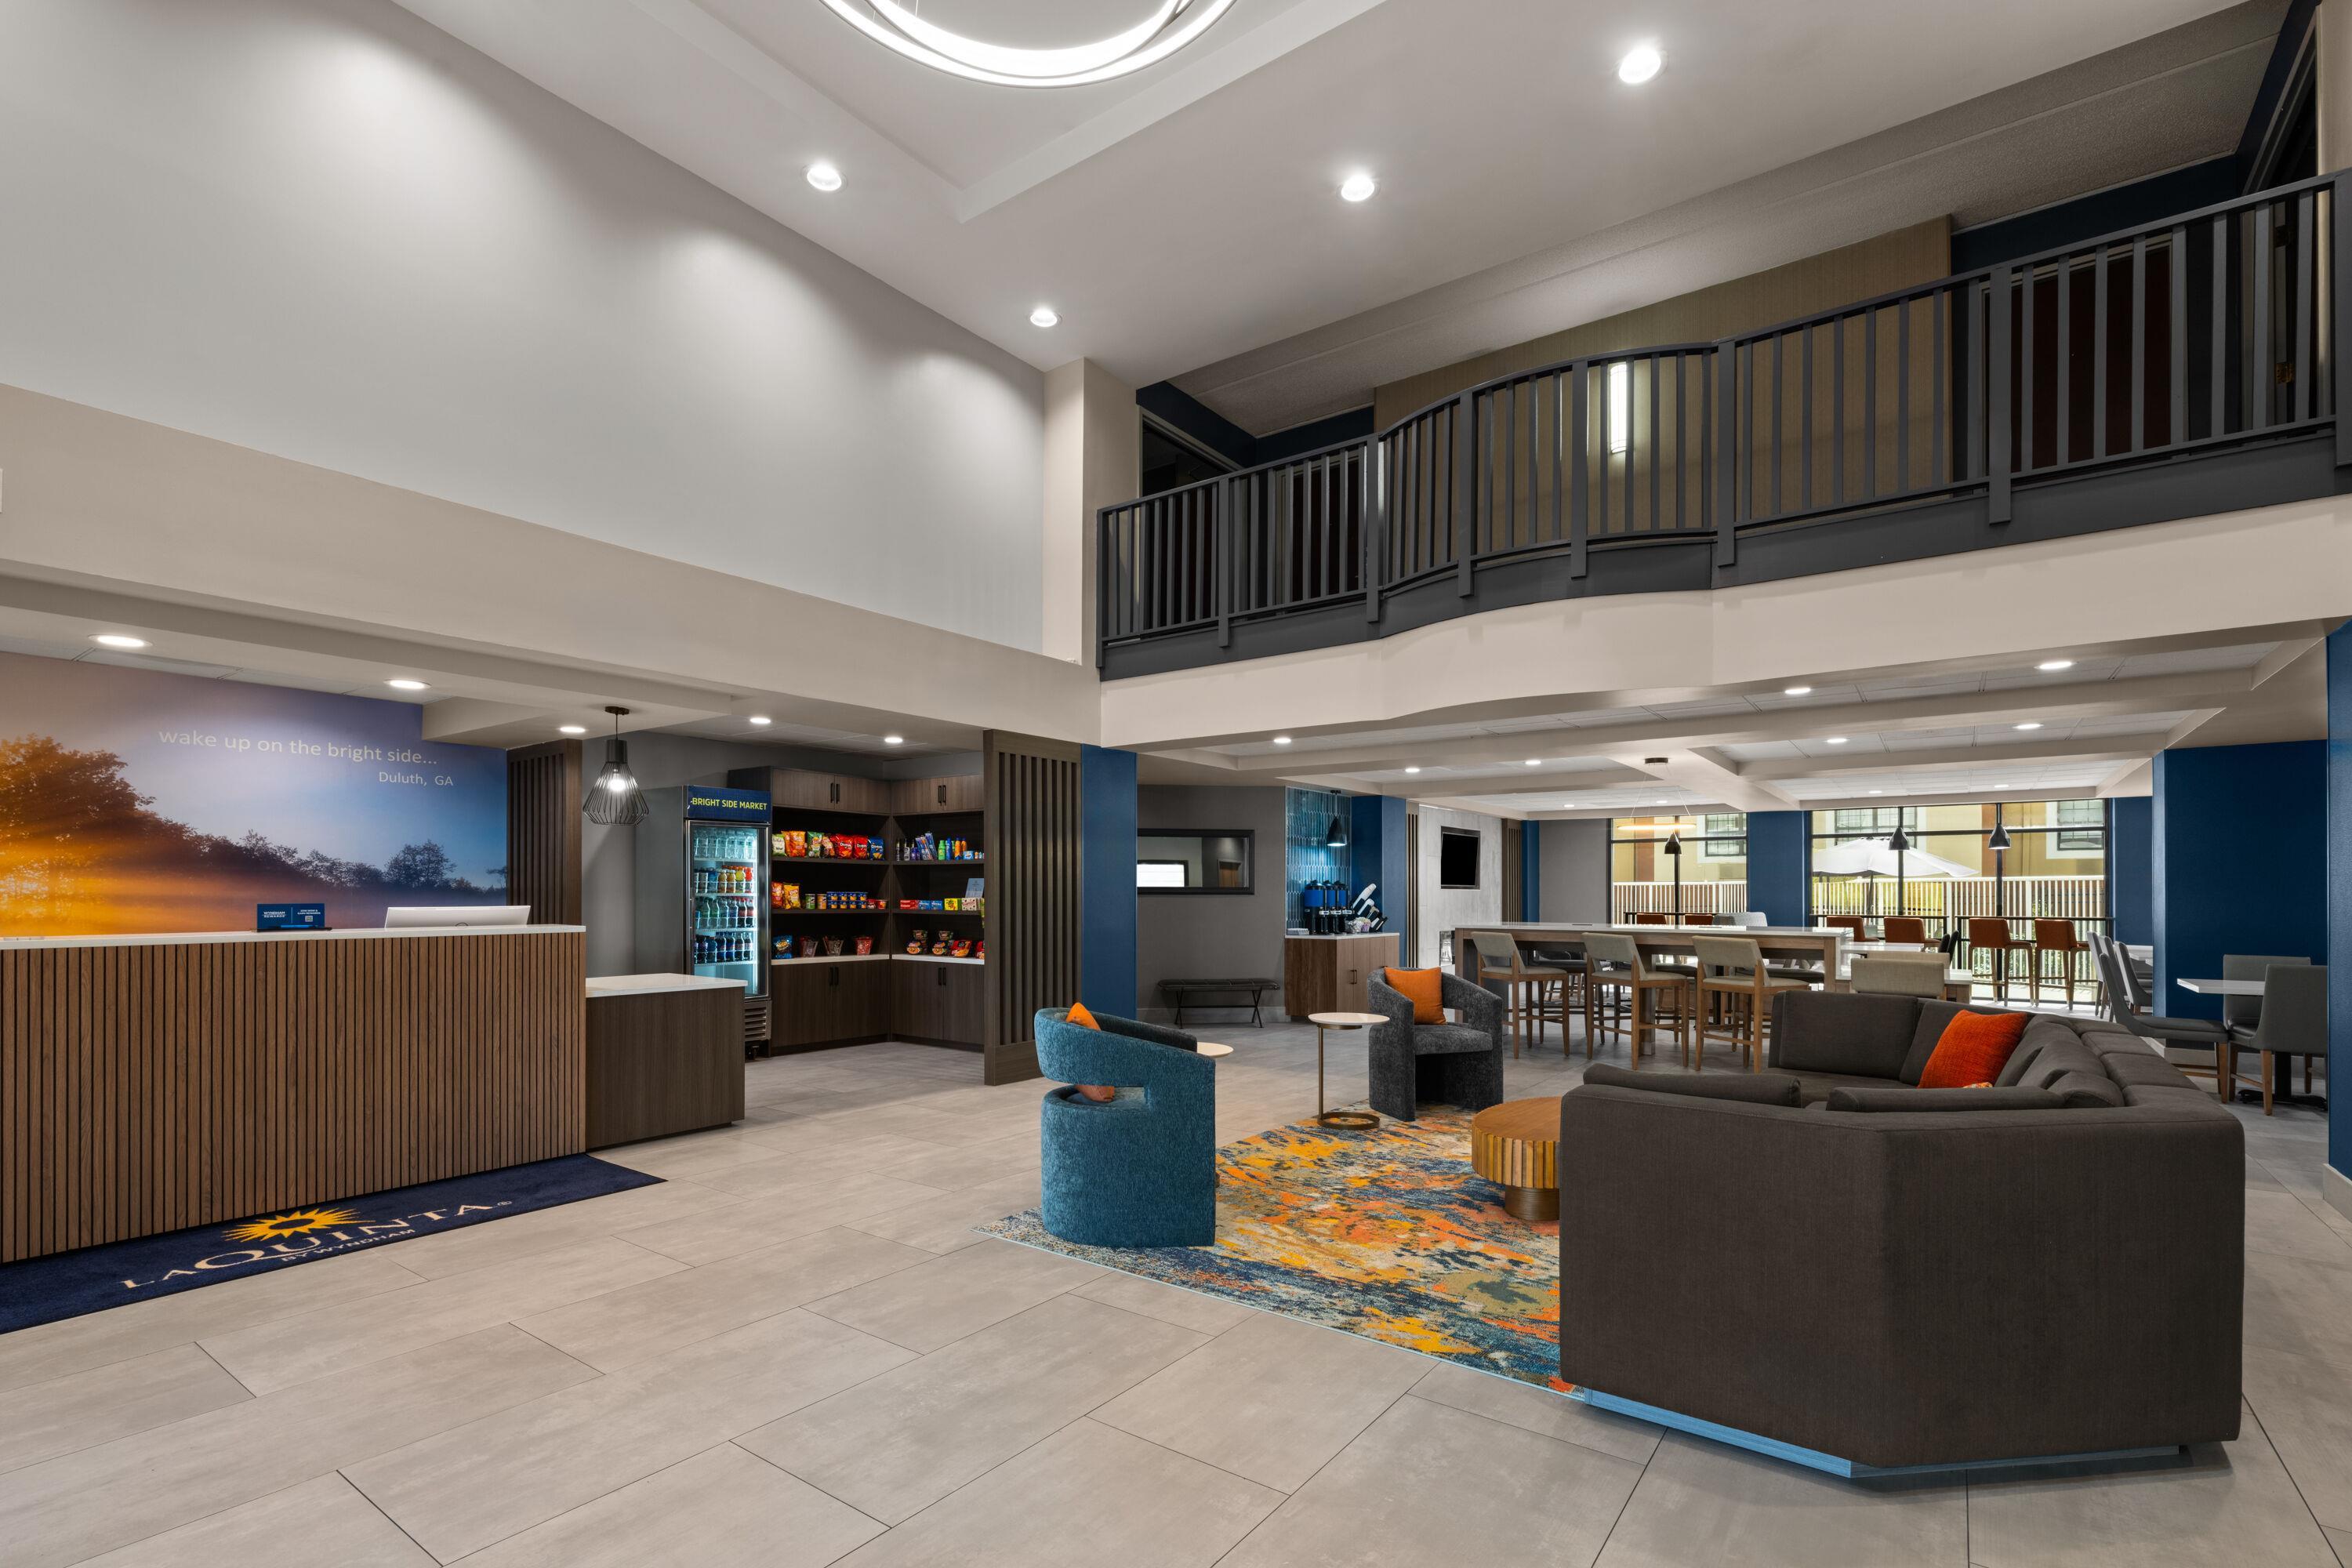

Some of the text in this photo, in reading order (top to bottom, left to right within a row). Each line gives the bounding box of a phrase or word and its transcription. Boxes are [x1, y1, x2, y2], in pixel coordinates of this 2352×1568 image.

[158, 730, 437, 764] wake up on the bright side...
[379, 771, 453, 786] Duluth, GA
[691, 797, 768, 811] BRIGHT SIDE MARKET
[281, 1229, 416, 1262] BY WYNDHAM
